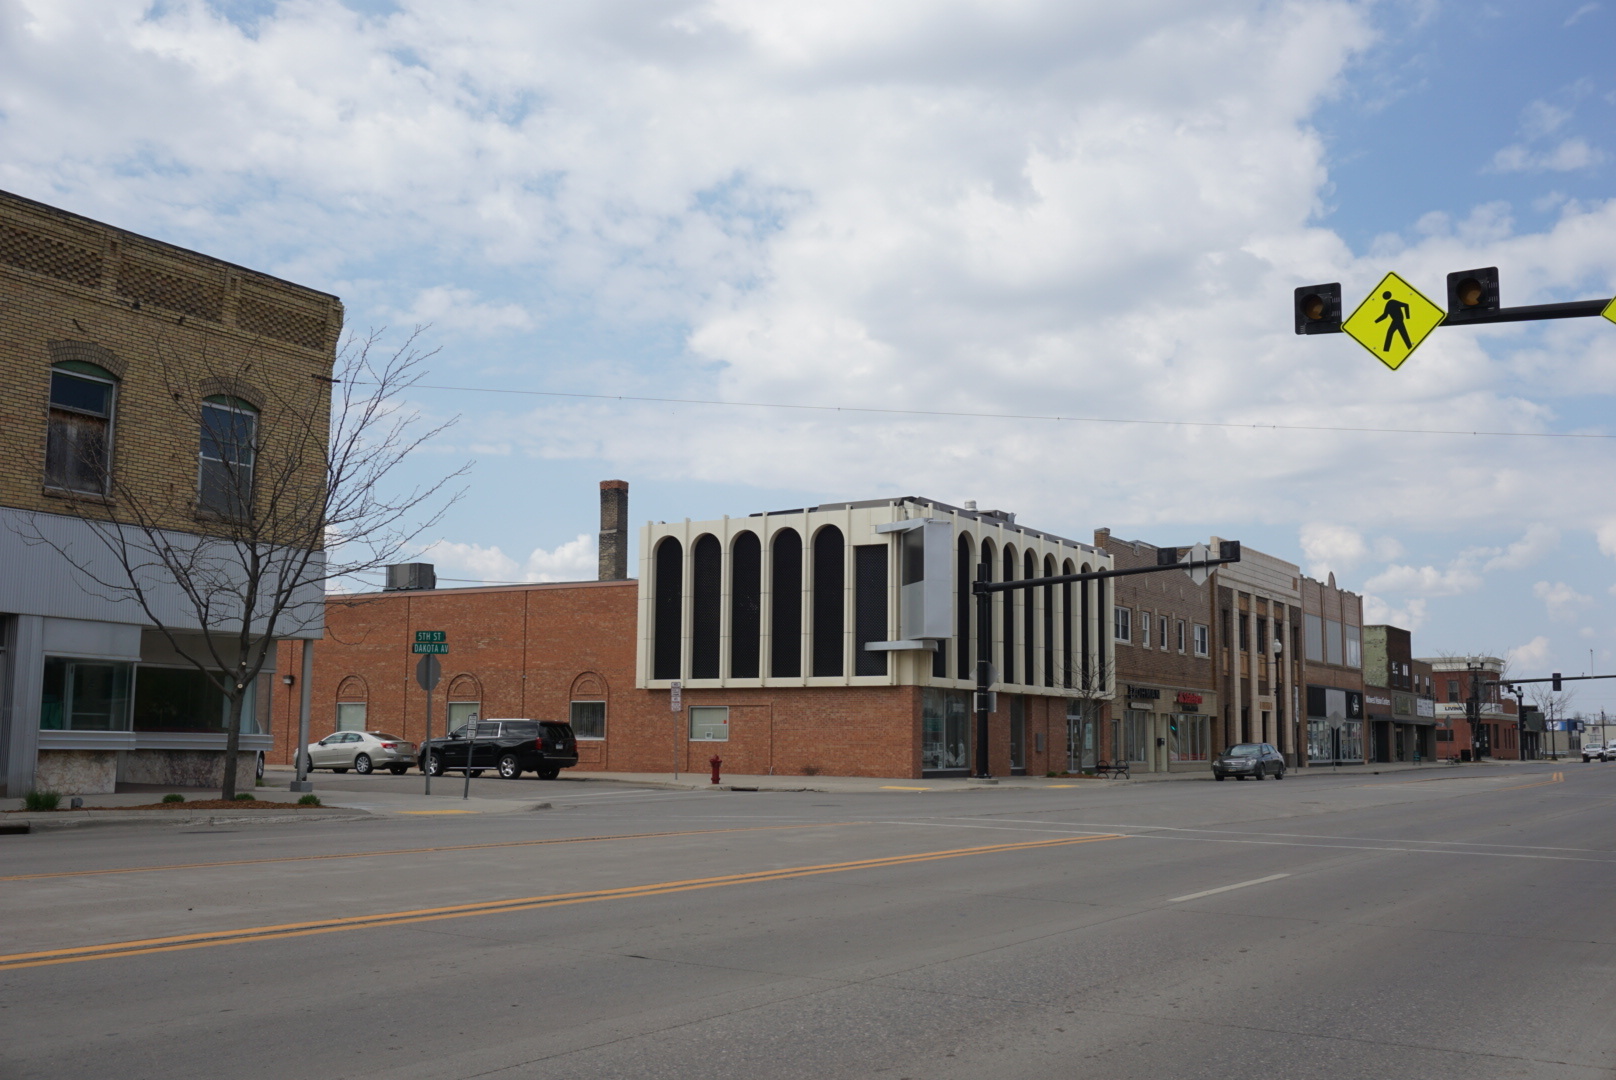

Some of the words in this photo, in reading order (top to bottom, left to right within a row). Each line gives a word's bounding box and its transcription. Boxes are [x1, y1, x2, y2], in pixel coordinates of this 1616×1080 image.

[418, 632, 431, 640] 5TH
[433, 632, 441, 640] ST
[414, 644, 438, 652] DAKOTA
[440, 644, 448, 653] AV
